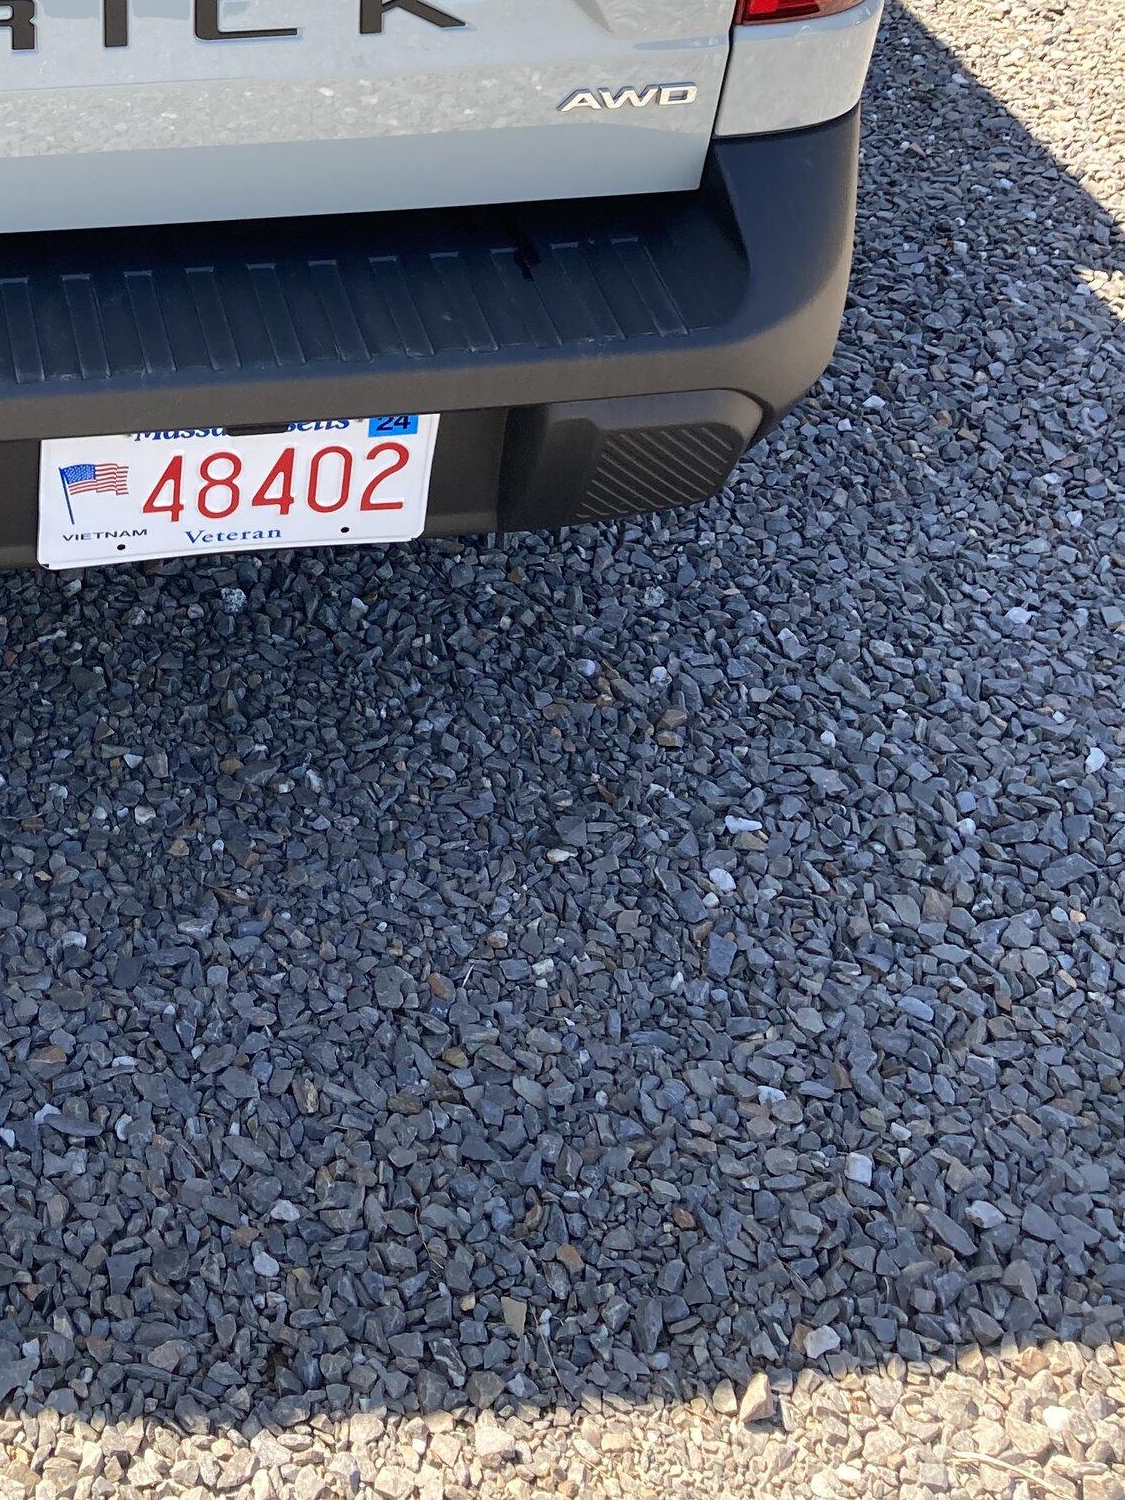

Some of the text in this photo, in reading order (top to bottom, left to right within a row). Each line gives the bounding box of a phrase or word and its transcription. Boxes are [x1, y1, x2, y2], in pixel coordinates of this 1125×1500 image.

[556, 81, 698, 112] AWD
[142, 441, 410, 523] 48402
[62, 528, 148, 542] VIETNAM
[185, 528, 282, 544] Veteran
